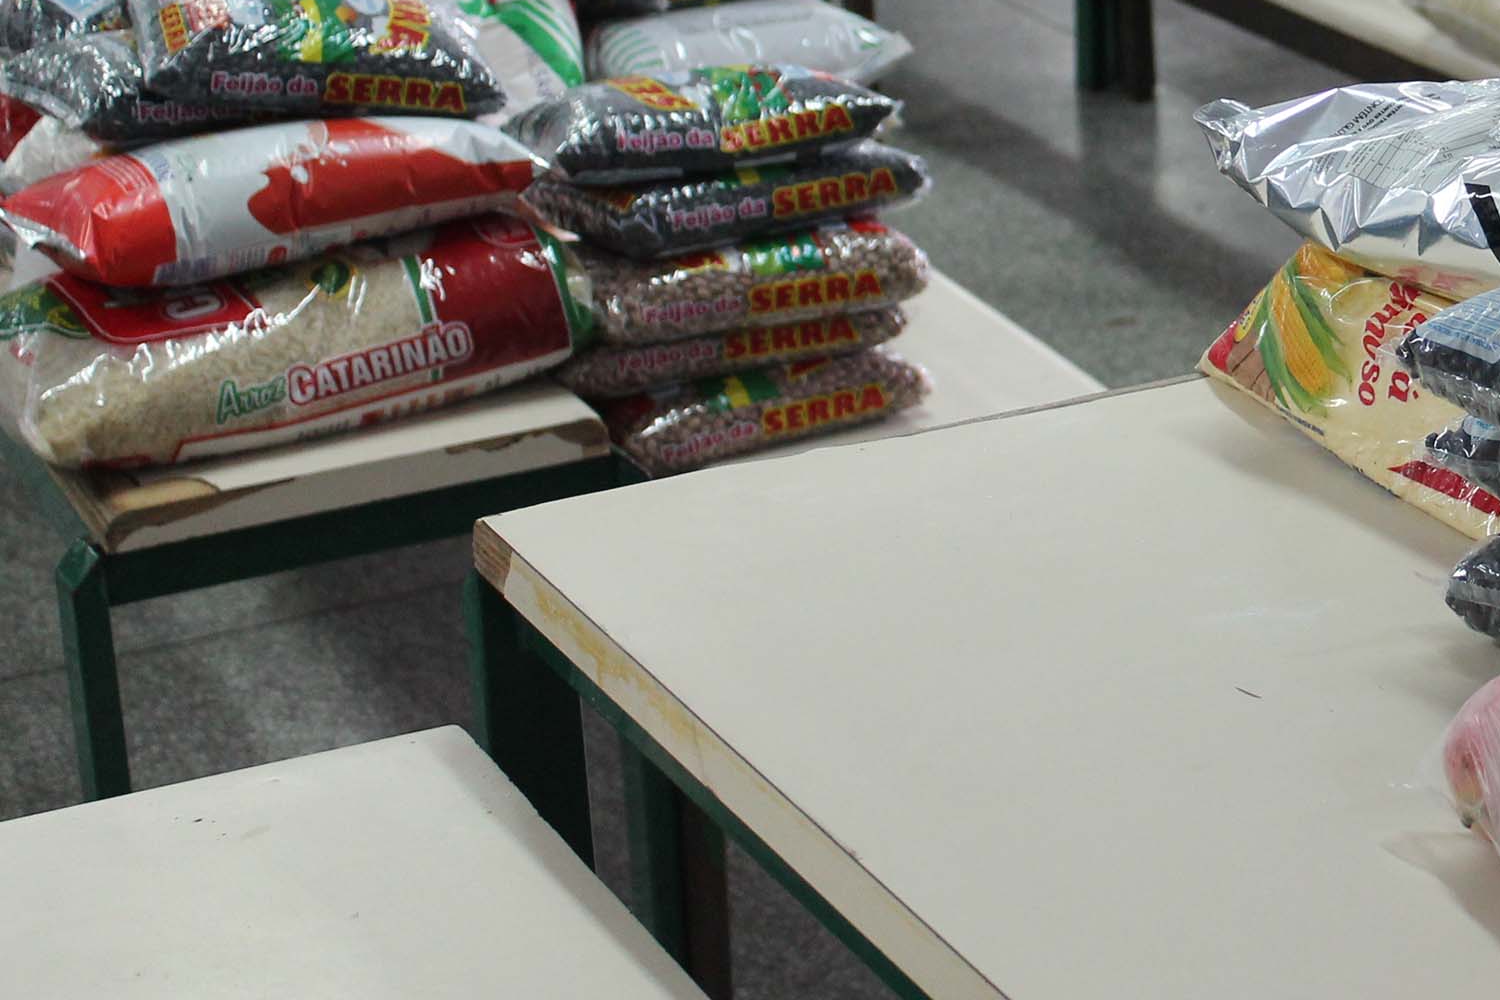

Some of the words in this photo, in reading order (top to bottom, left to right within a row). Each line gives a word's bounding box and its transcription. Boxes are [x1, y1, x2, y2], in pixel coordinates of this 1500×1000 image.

[211, 70, 282, 98] Feijão
[287, 71, 318, 96] da
[325, 72, 466, 112] SERRA
[618, 132, 681, 157] Feijão
[687, 129, 716, 149] da
[719, 103, 855, 153] SERRA
[671, 203, 735, 233] Feijão
[739, 198, 767, 218] da
[772, 167, 898, 218] SERRA
[643, 300, 709, 326] Feijão
[714, 296, 742, 314] da
[749, 269, 882, 315] SERRA
[285, 320, 474, 406] CATARINÃO
[618, 347, 686, 373] Feijão
[690, 343, 717, 361] da
[723, 316, 861, 360] SERRA
[661, 432, 724, 462] Feijão
[728, 421, 758, 440] da
[761, 383, 893, 437] SERRA
